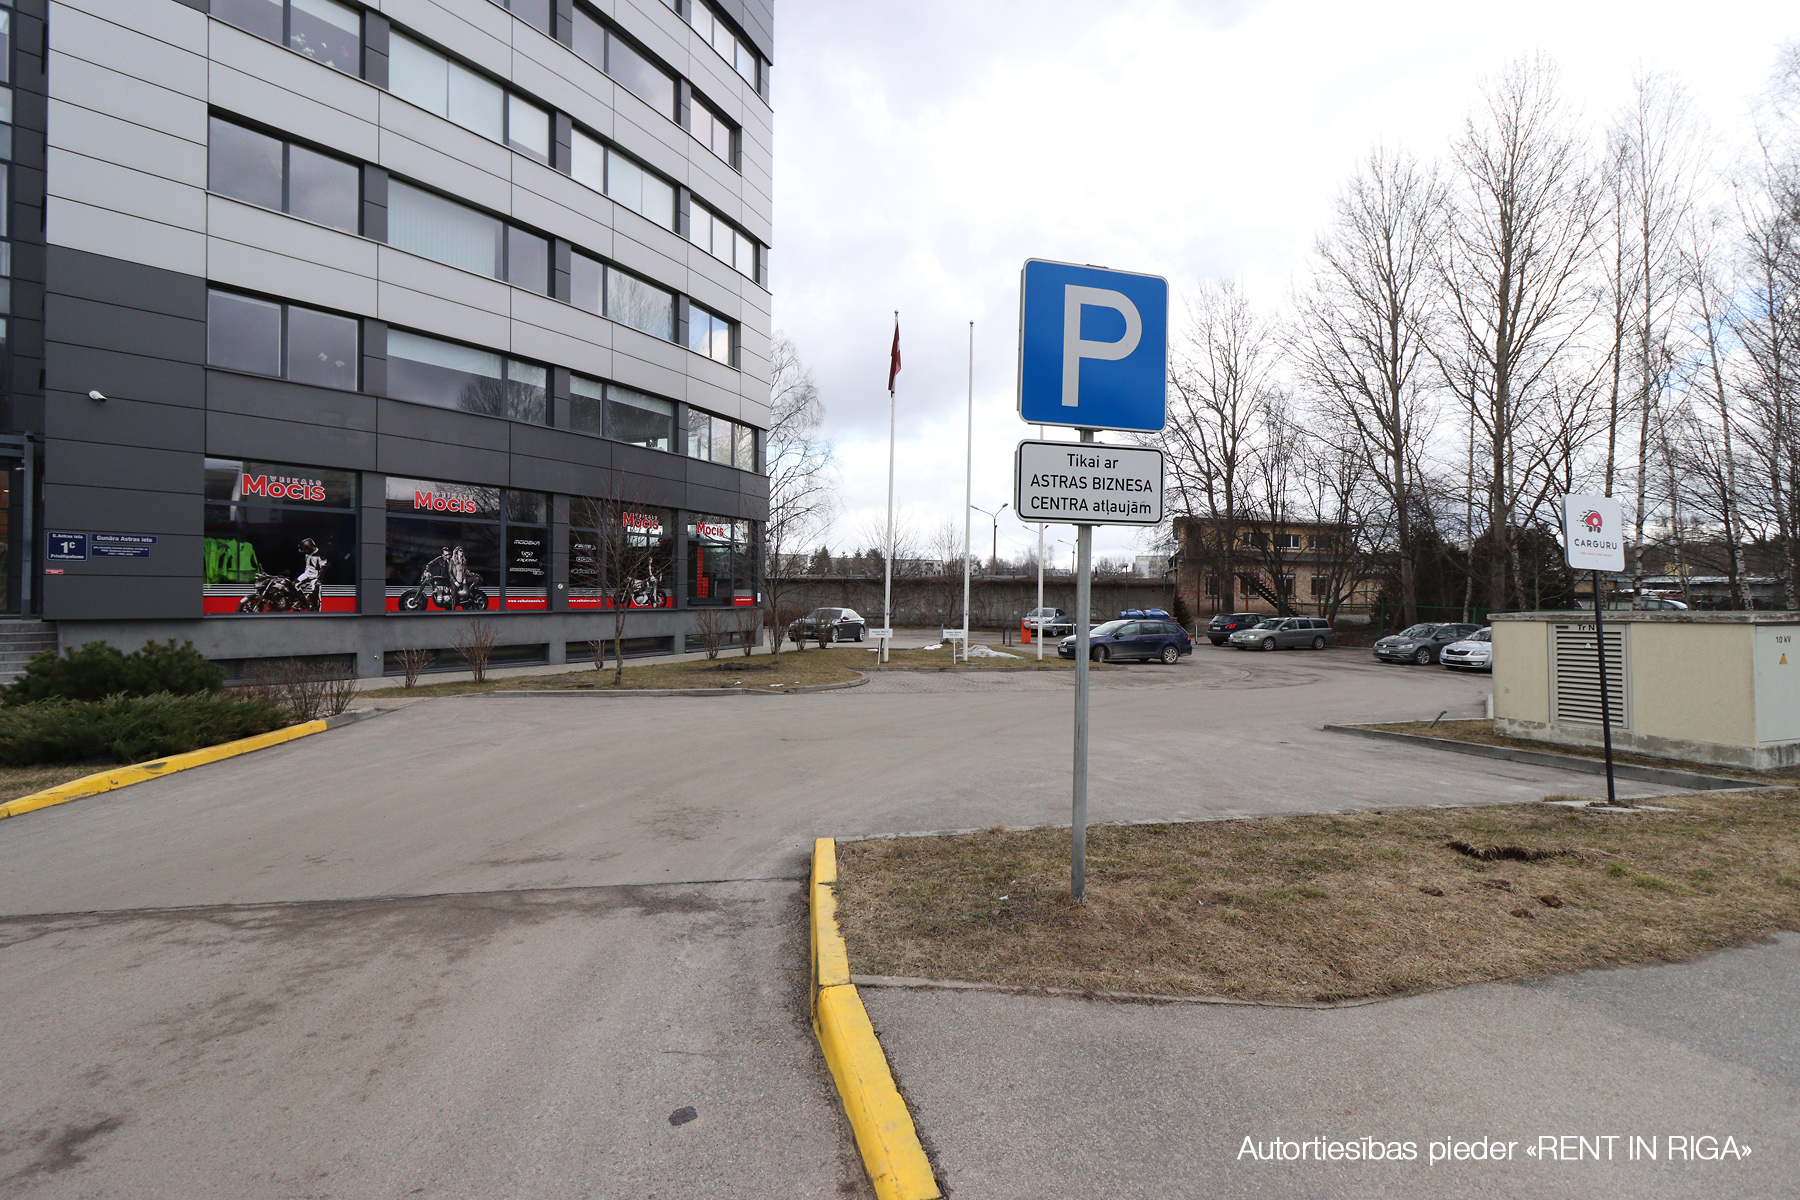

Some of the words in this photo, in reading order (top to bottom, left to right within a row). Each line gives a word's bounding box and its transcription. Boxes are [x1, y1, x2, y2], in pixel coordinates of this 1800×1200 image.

[1062, 284, 1142, 407] P
[1067, 453, 1100, 468] Tikai
[1104, 458, 1119, 469] ar
[241, 473, 326, 502] MOCIS
[270, 475, 322, 486] VEIKALS
[1030, 473, 1088, 490] ASTRAS
[1092, 476, 1153, 493] BIZNESA
[413, 489, 477, 514] MOCIS
[1031, 495, 1088, 512] CENTRA
[1093, 499, 1151, 517] atļaujām
[696, 521, 724, 537] MOCIS
[120, 535, 140, 543] Astras
[1574, 538, 1618, 550] CARGURU
[1775, 635, 1783, 644] 10
